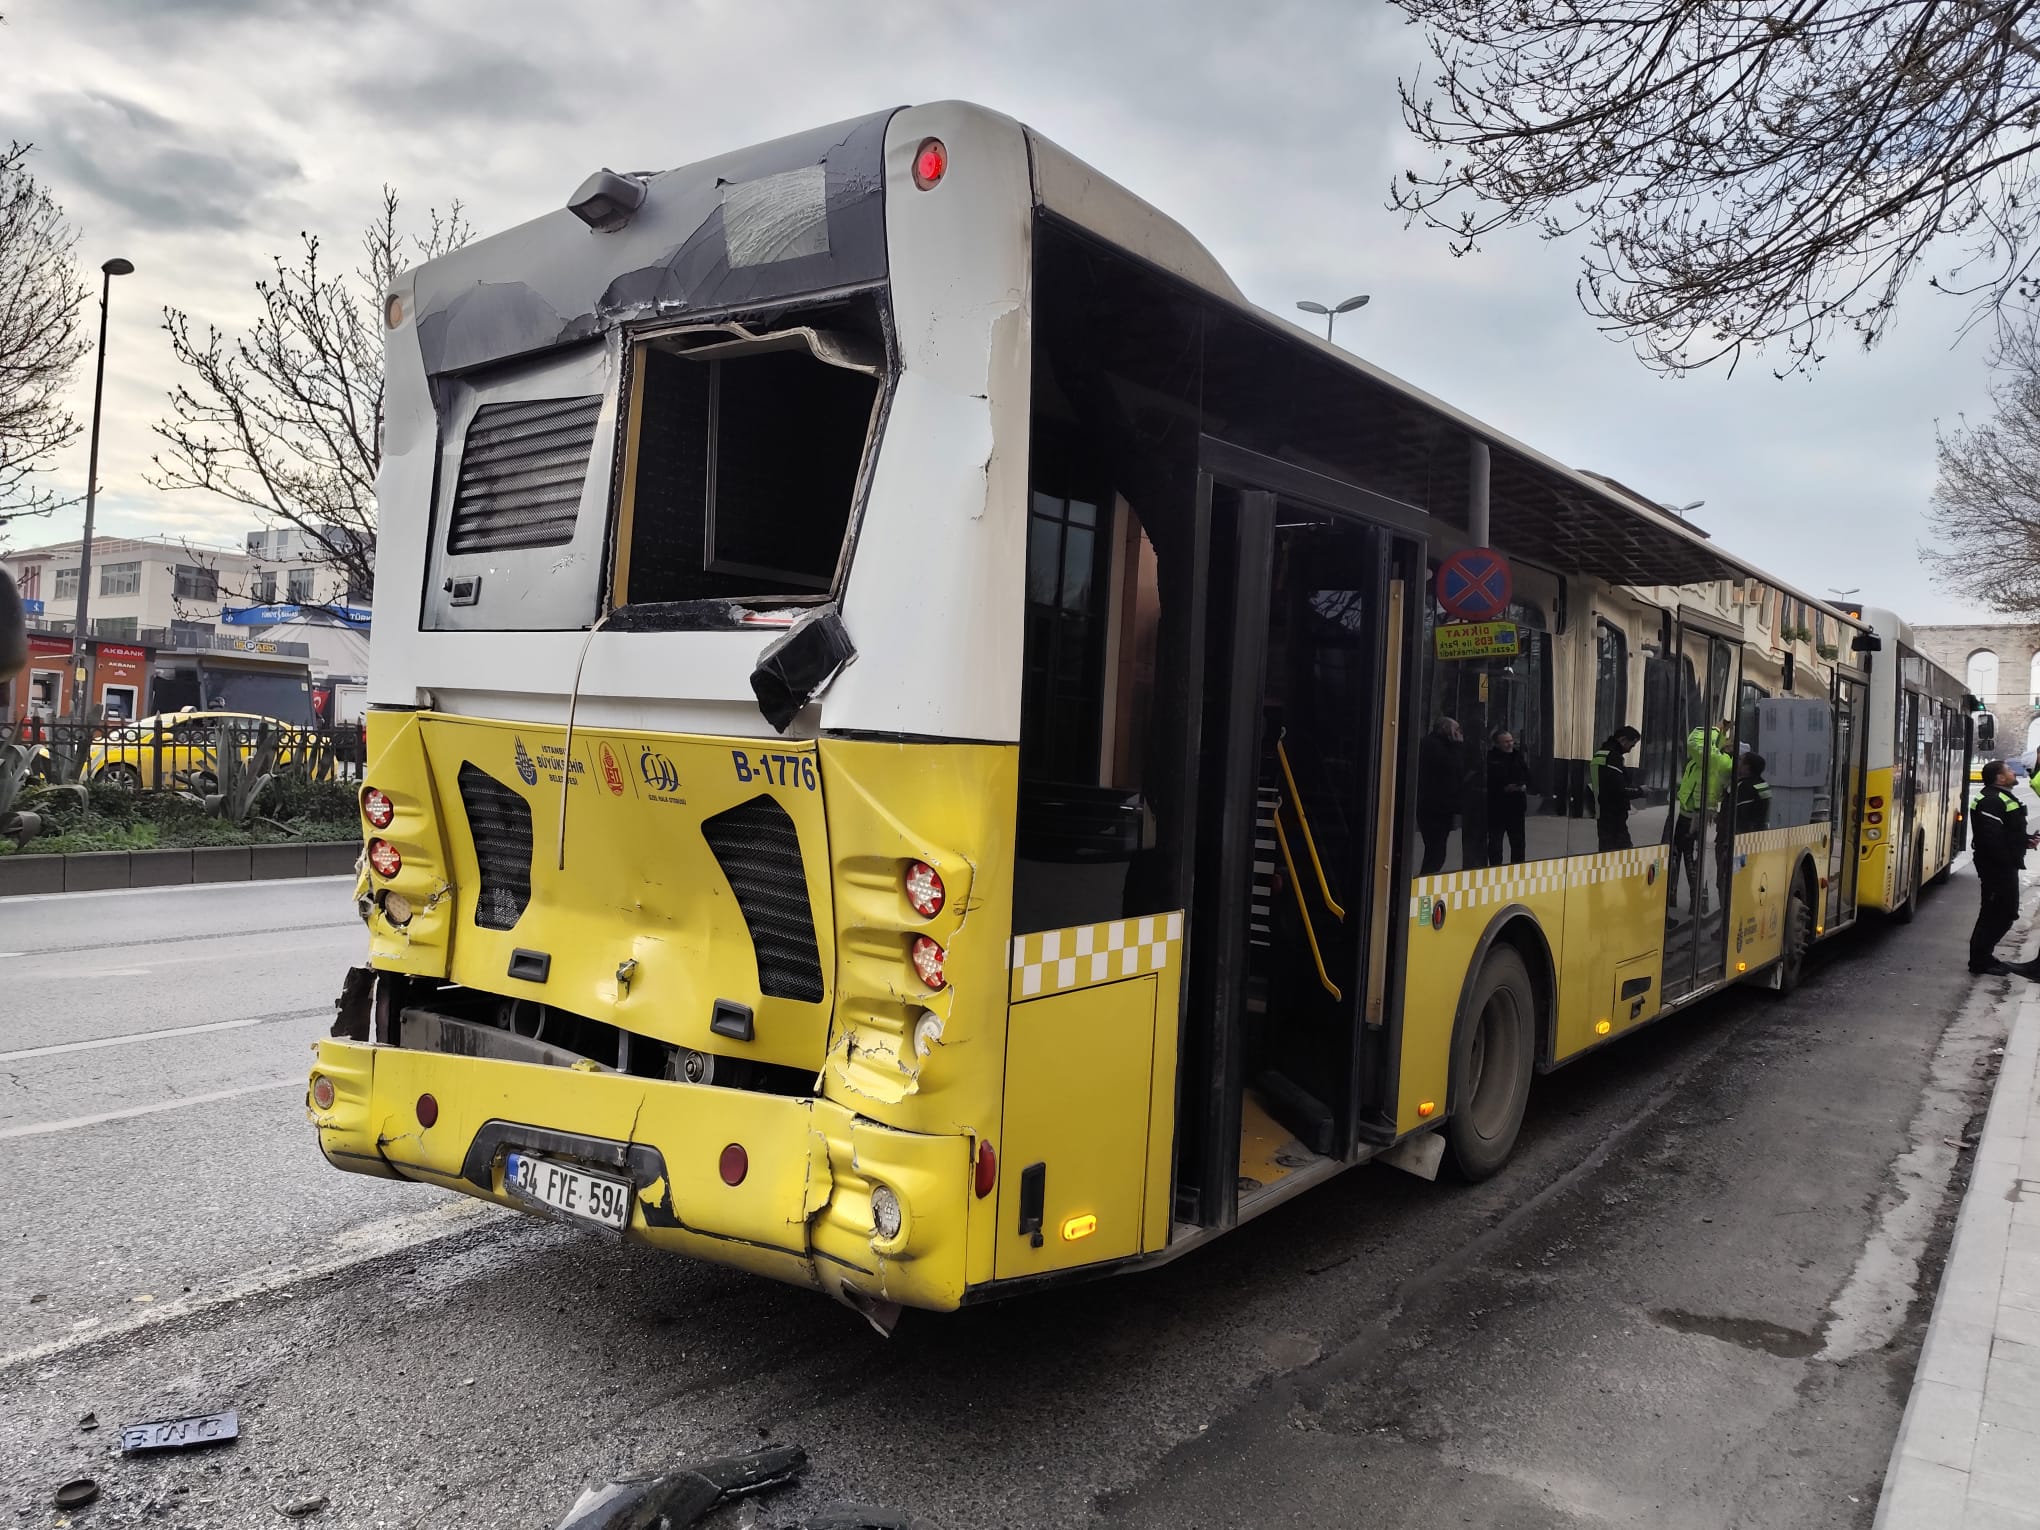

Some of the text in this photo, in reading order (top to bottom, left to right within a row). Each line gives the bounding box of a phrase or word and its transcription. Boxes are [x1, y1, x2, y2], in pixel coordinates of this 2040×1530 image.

[103, 647, 144, 657] AKBANK
[108, 661, 136, 669] AKBANK
[731, 751, 816, 791] B-1776
[509, 1174, 517, 1183] TR
[518, 1160, 538, 1195] 34
[546, 1168, 578, 1209] FYE
[588, 1181, 624, 1222] 594
